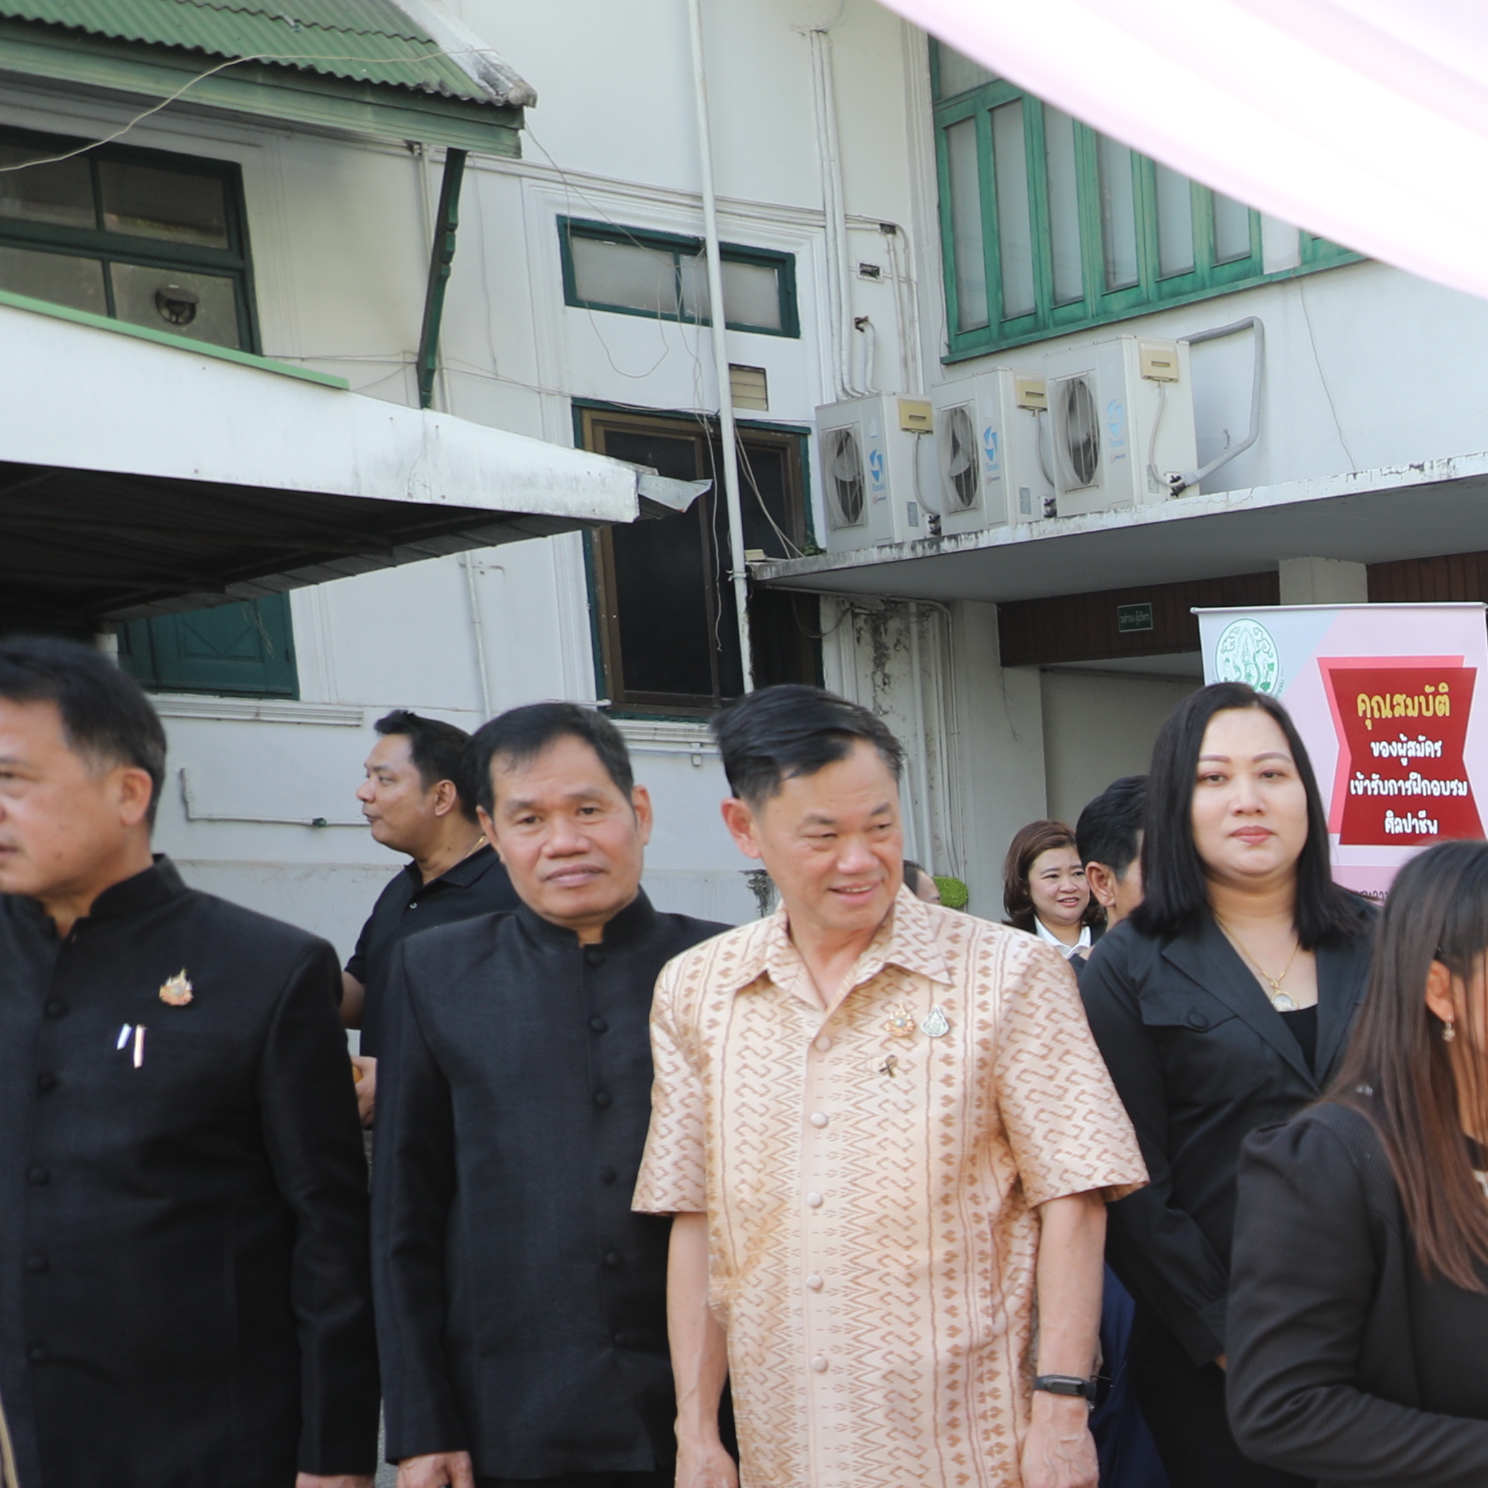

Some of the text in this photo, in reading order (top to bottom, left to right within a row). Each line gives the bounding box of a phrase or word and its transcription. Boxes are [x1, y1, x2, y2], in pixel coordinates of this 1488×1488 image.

[1357, 682, 1450, 730] คุณสมบัติ
[1370, 733, 1443, 766] ของผู้สมัคร
[1350, 771, 1468, 796] เข้ารับการฝึกอบรม
[1384, 809, 1438, 834] ศิลปาชีพ
